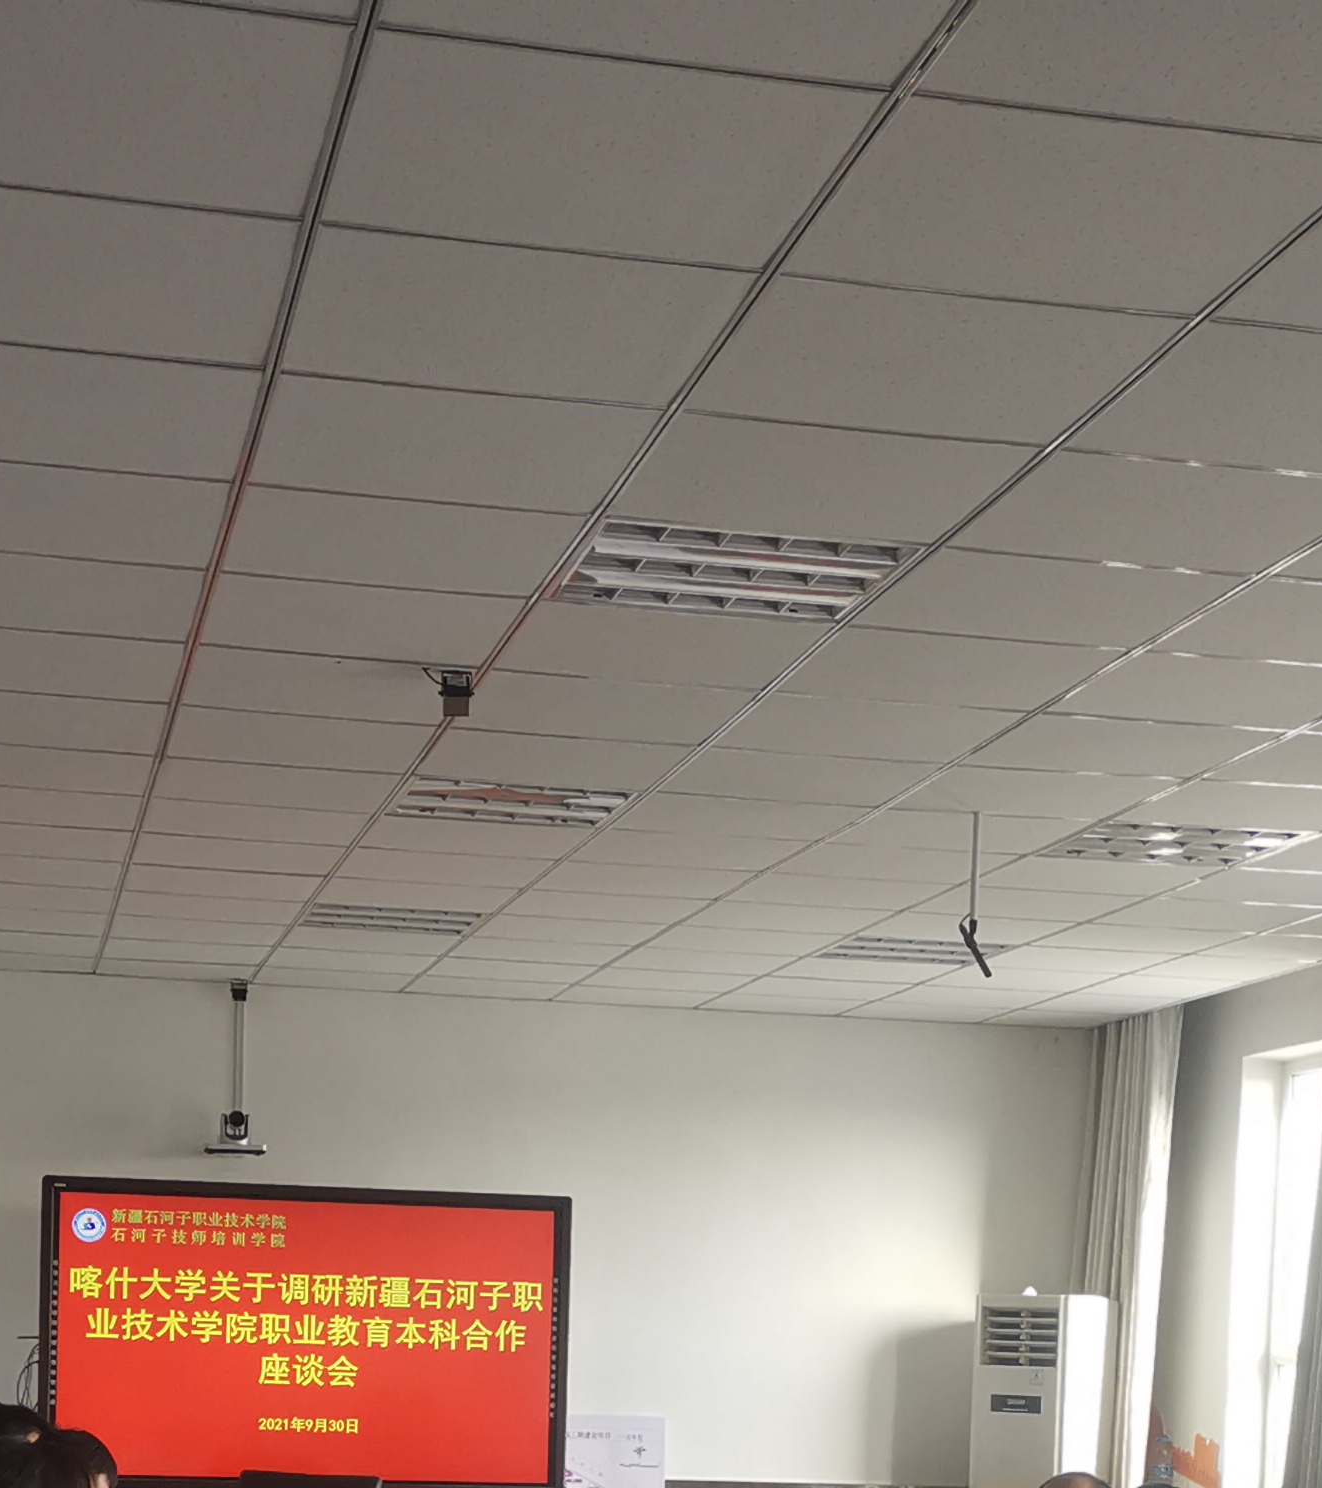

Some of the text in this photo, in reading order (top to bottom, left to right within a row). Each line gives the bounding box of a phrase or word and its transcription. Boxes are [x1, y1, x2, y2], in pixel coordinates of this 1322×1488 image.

[111, 1208, 287, 1230] 新疆石河子职业技术学院
[110, 1227, 287, 1249] 石河子技师培训学院
[69, 1265, 545, 1313] 喀什大学关于调研新疆石河子职
[85, 1307, 528, 1353] 业技术学院职业教育本科合作
[258, 1353, 359, 1388] 座谈会
[258, 1416, 360, 1435] 2021年9月30日
